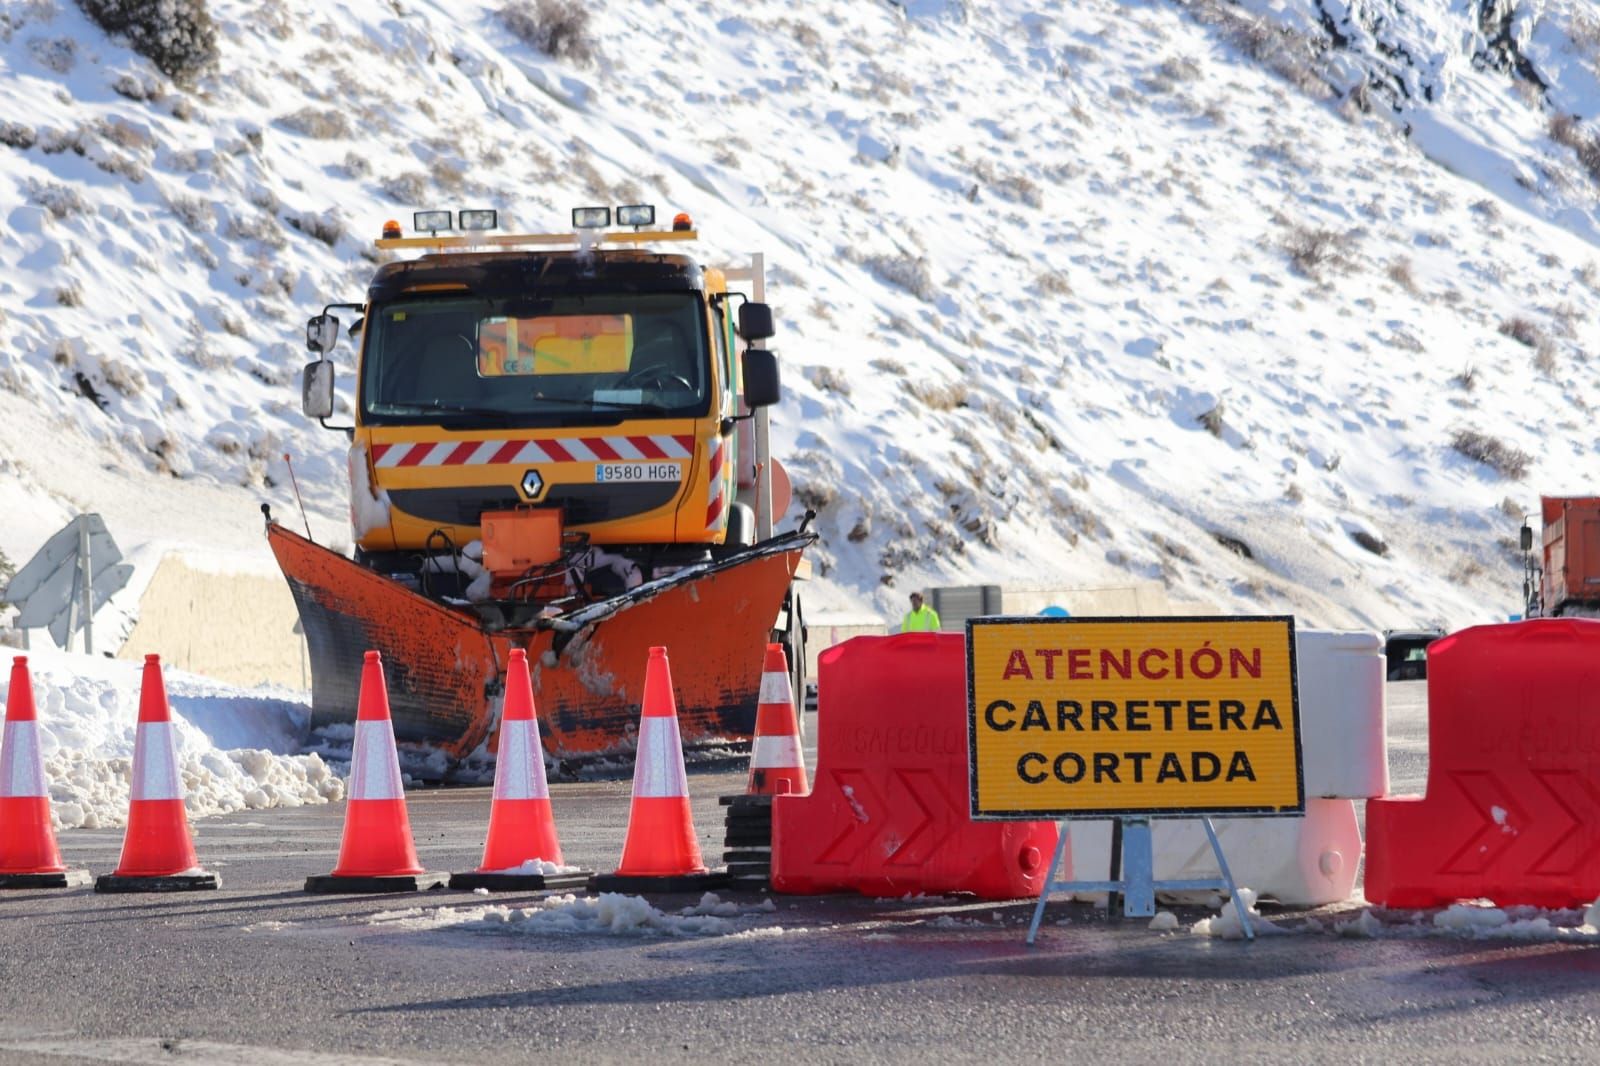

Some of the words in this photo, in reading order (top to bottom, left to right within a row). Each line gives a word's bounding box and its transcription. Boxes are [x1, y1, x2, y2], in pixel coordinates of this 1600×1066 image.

[605, 466, 641, 479] 9580
[649, 466, 676, 478] HGR
[1003, 641, 1261, 680] ATENCIÓN
[985, 700, 1283, 731] CARRETERA
[1017, 751, 1256, 784] CORTADA
